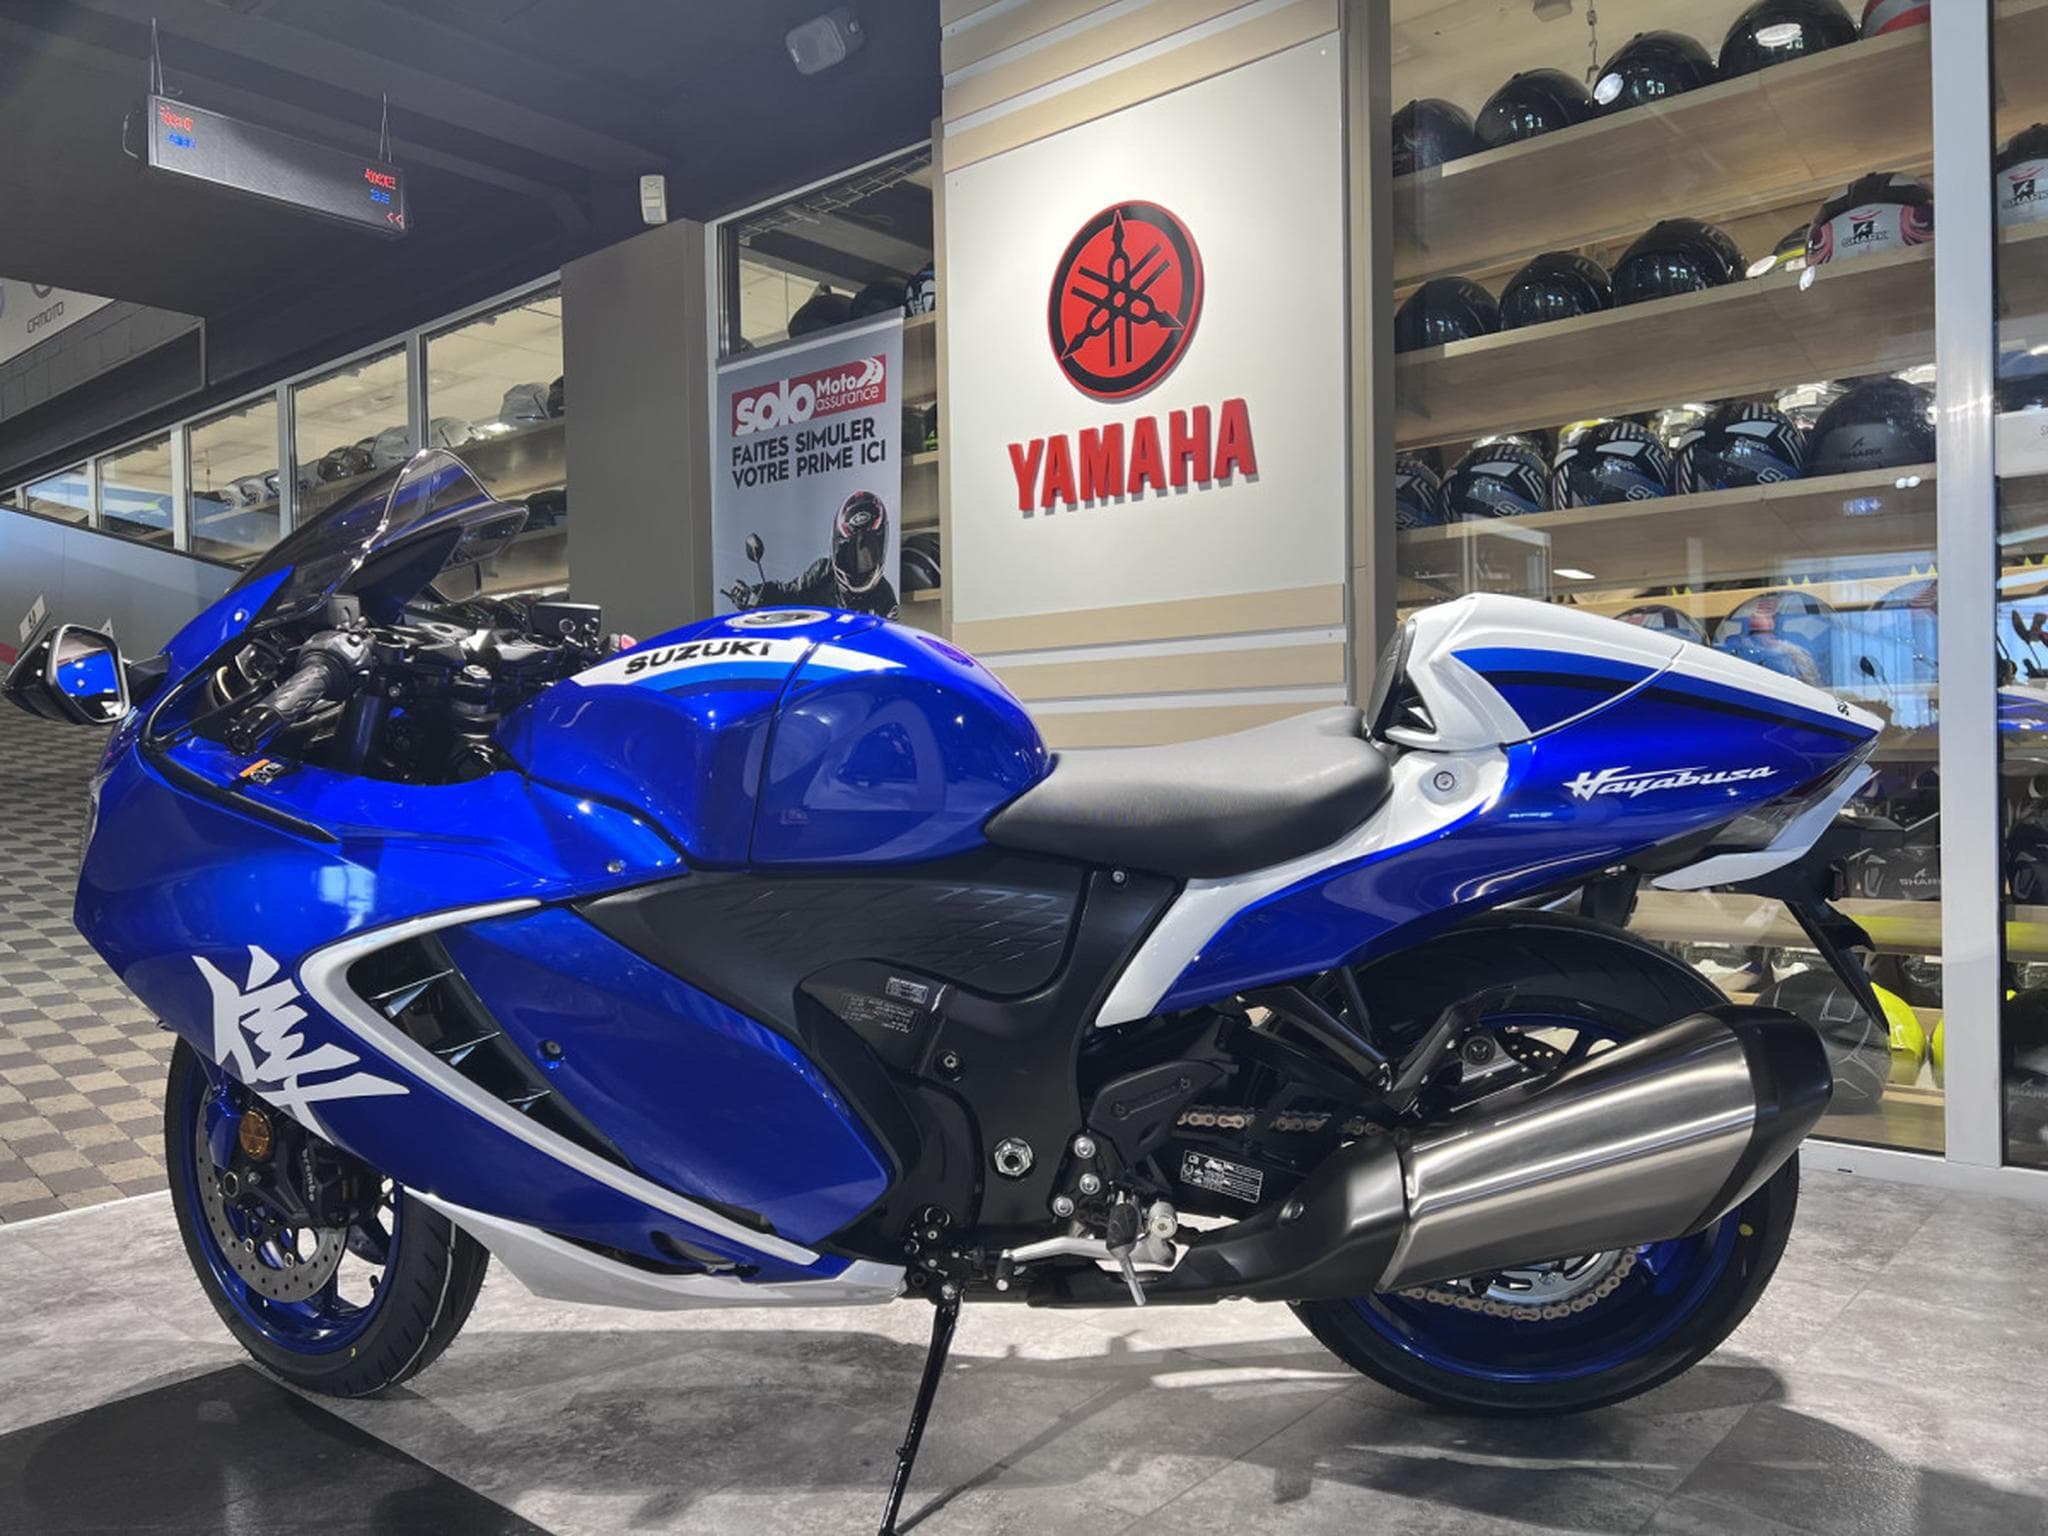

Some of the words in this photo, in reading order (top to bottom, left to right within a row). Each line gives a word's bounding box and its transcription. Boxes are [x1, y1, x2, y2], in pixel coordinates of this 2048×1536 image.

[735, 379, 815, 436] solo
[815, 373, 857, 398] Moto
[815, 385, 880, 412] assurance
[731, 435, 790, 468] FAITES
[795, 417, 876, 453] SIMULER
[731, 459, 790, 490] VOTRE
[796, 446, 853, 478] PRIME
[860, 439, 887, 466] ICI
[1007, 396, 1259, 512] YAMAHA
[624, 640, 774, 675] SUZUKI
[1562, 765, 1780, 801] Hayabusa
